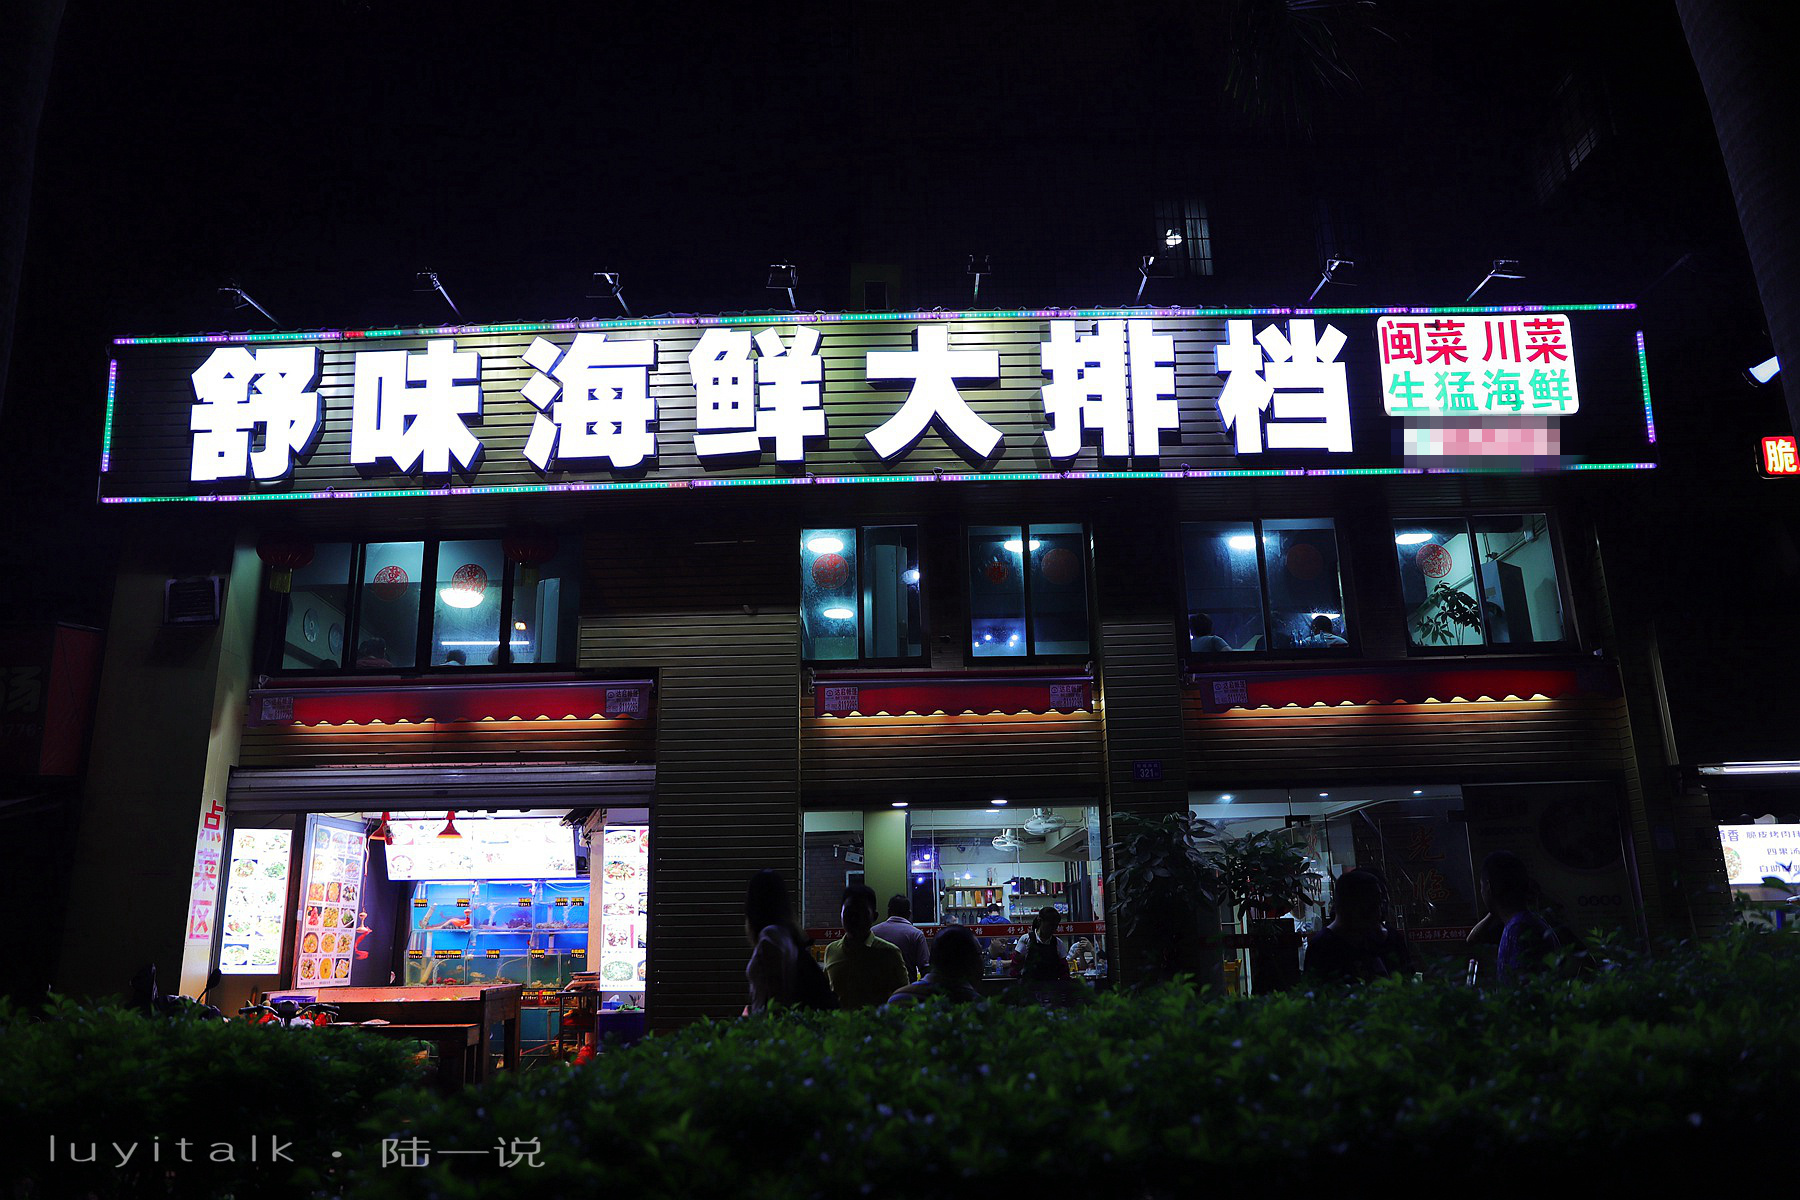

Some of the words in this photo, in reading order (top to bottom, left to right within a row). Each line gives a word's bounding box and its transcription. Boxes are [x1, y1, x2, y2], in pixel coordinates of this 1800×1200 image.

[1381, 319, 1469, 365] 闽菜
[1482, 318, 1569, 363] 川菜
[190, 319, 1354, 482] 舒味海鲜大排档
[1389, 367, 1573, 412] 生猛海鲜
[1765, 439, 1798, 473] 脆
[188, 800, 224, 940] 点菜区
